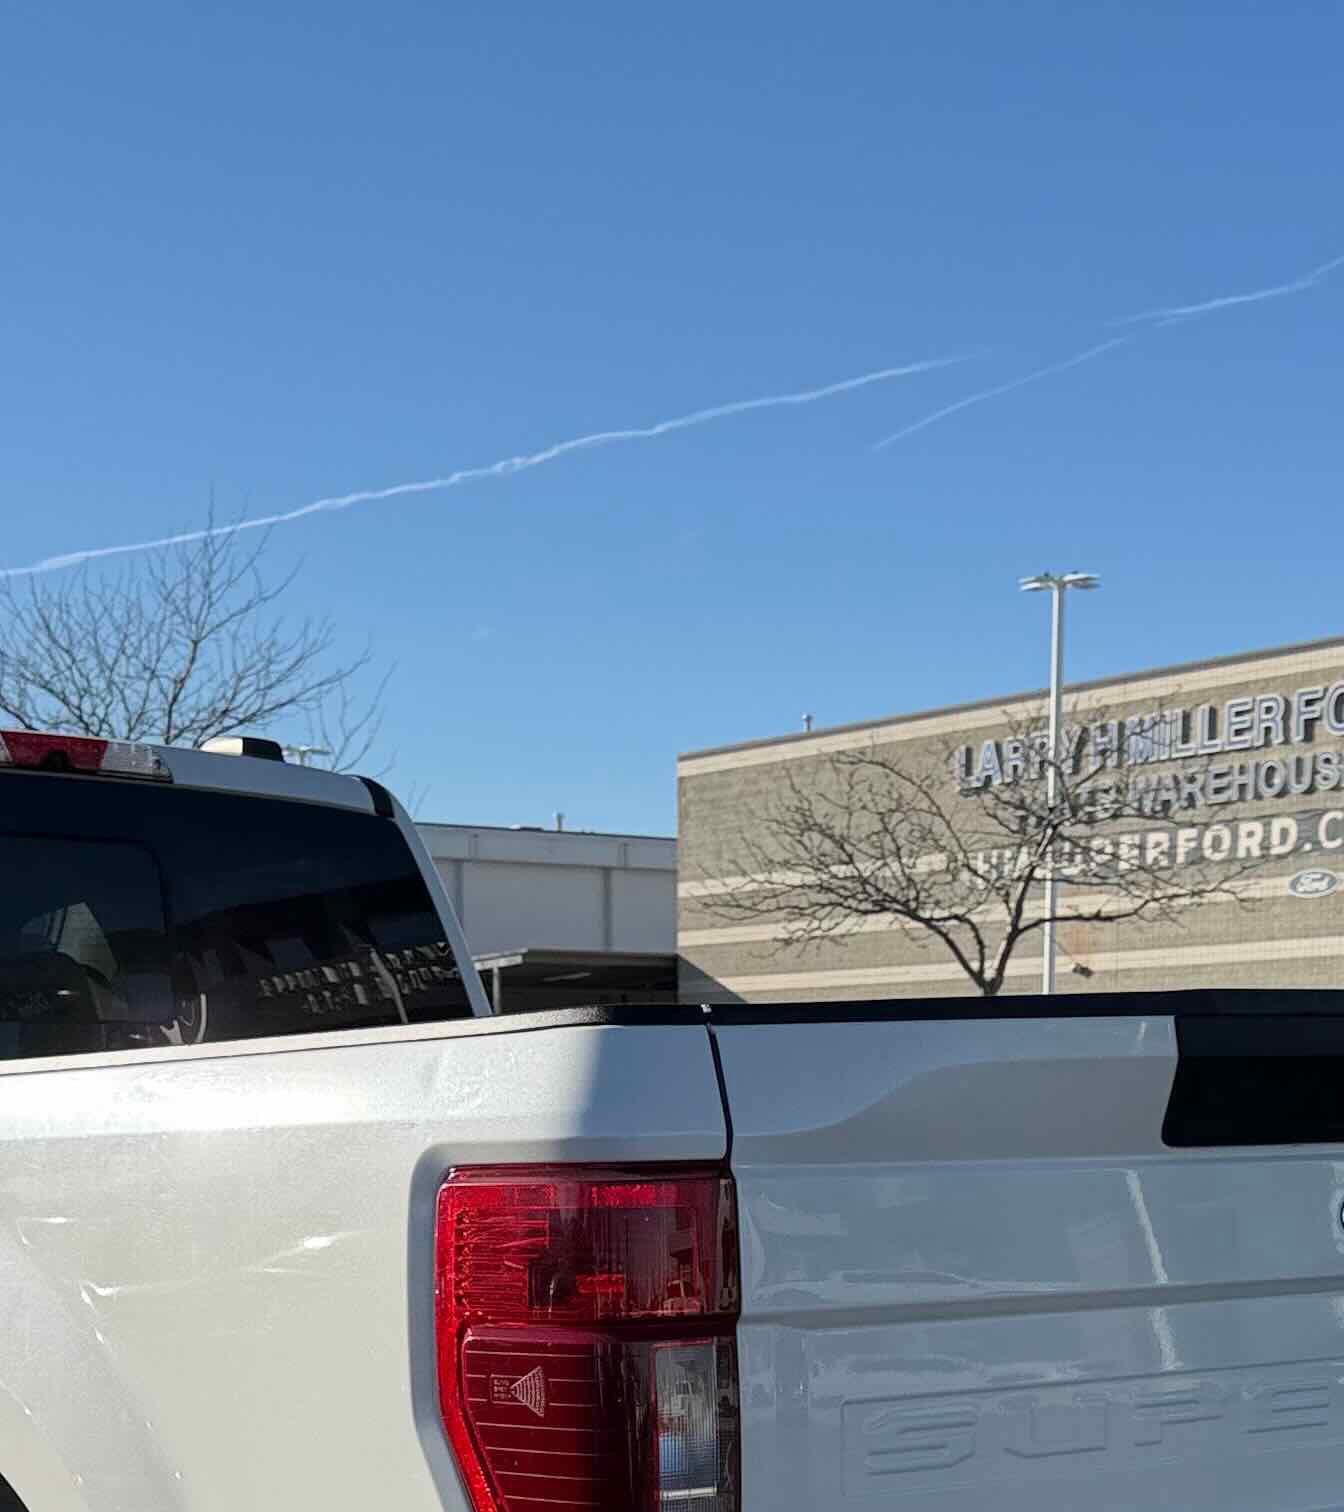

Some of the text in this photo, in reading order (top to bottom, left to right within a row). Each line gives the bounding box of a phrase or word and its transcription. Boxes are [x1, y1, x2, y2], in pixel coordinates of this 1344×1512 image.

[959, 724, 1083, 793] LARRY
[1088, 719, 1121, 770] H
[1126, 693, 1287, 766] MILLER
